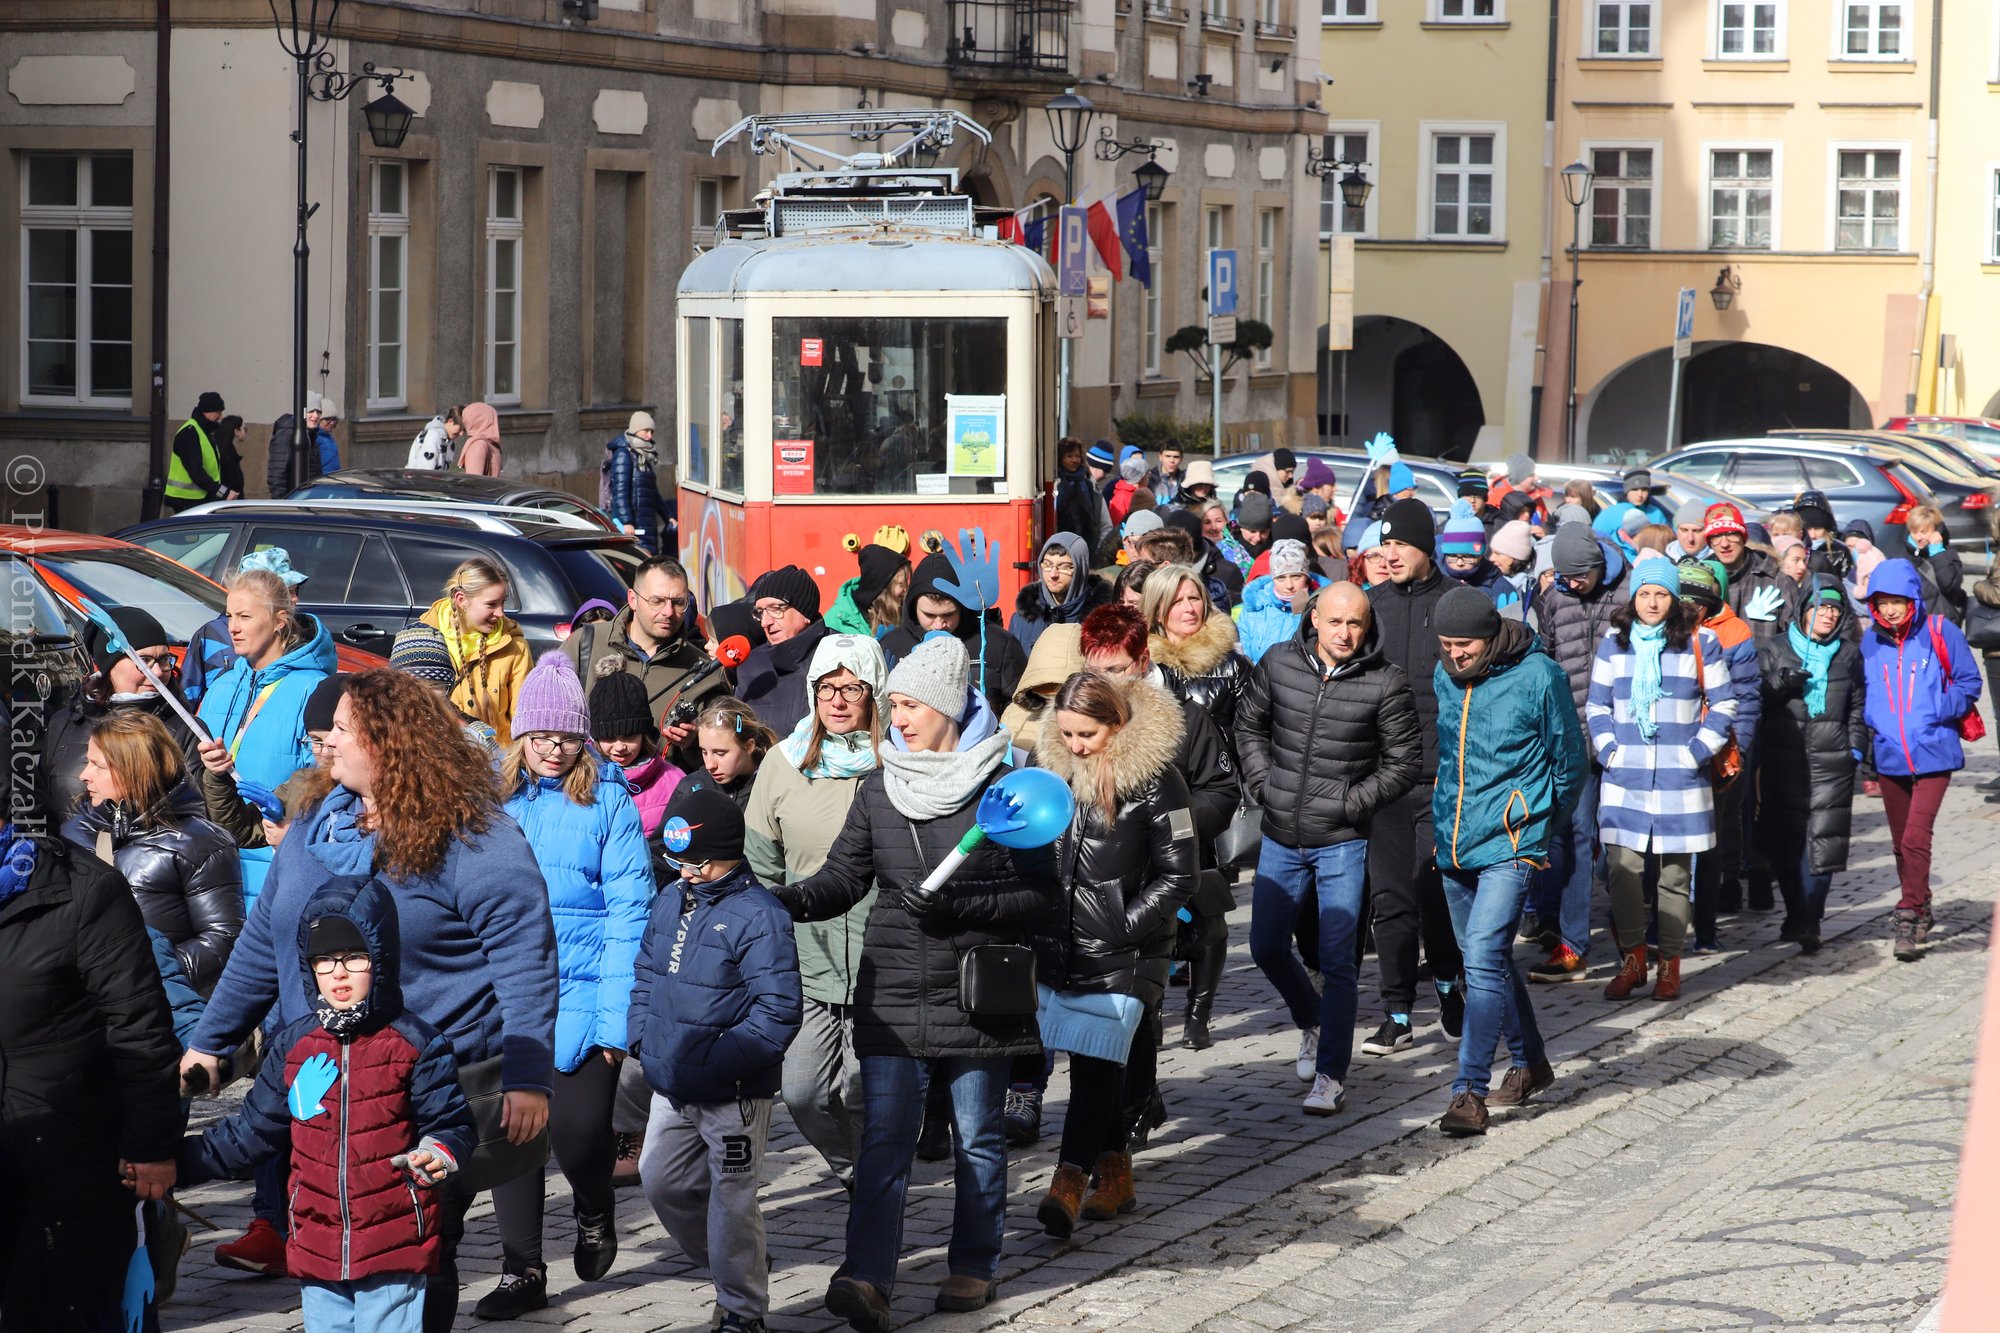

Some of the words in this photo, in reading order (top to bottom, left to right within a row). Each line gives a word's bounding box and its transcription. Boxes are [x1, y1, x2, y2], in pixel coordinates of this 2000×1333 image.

[1065, 215, 1083, 269] P
[1215, 257, 1232, 308] P
[663, 829, 690, 842] NASA
